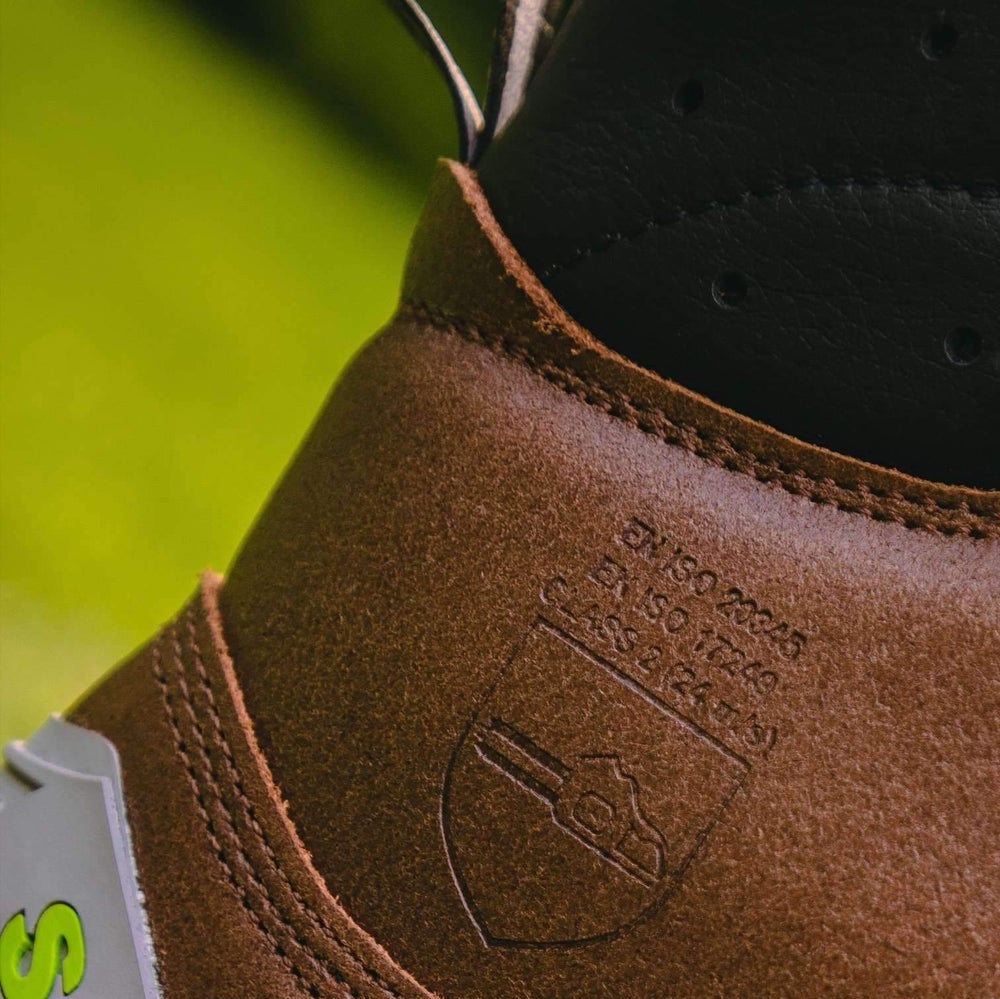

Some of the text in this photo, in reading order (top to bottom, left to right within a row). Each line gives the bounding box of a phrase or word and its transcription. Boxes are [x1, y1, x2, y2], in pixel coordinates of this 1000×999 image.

[540, 576, 639, 653] CLASS
[637, 588, 689, 634] ISO
[662, 548, 718, 596] ISO
[716, 587, 807, 661] 20345
